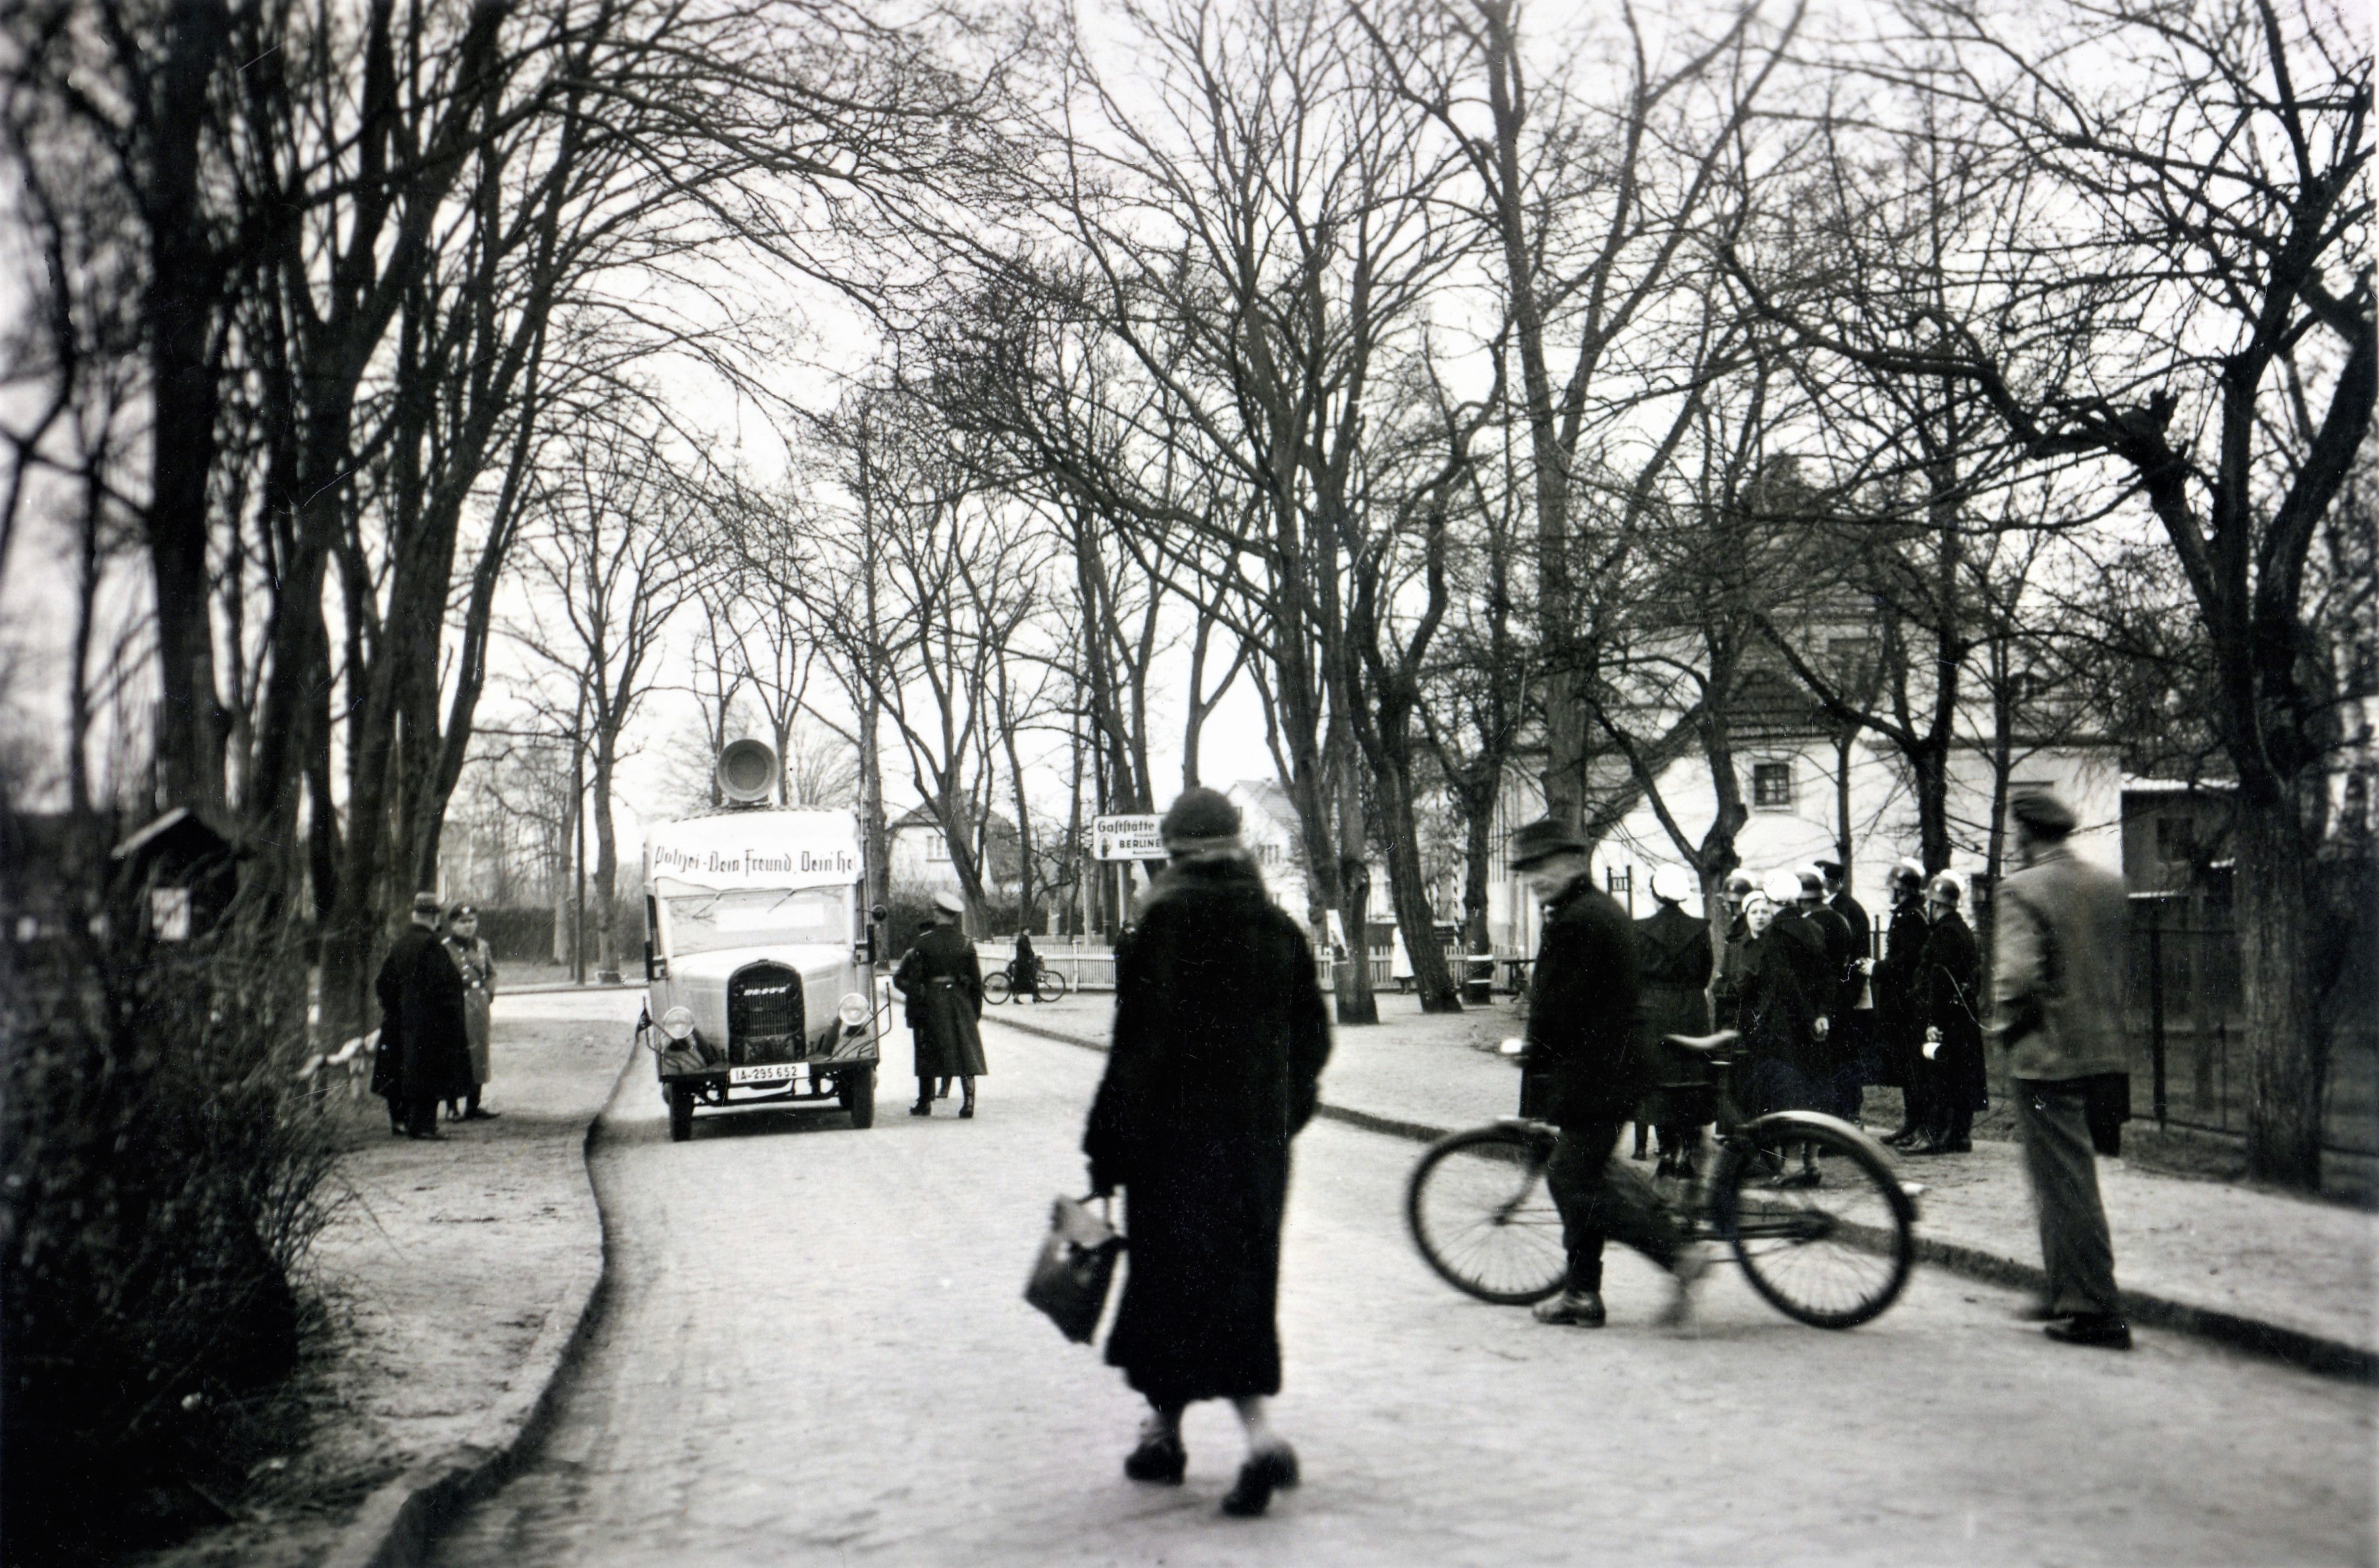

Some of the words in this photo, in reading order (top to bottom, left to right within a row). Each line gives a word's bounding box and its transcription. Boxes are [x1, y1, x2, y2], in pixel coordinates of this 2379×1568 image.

[1119, 839, 1161, 849] BERLINE
[654, 845, 700, 874] Polizei
[709, 850, 740, 873] Dein
[801, 850, 833, 872] Dein
